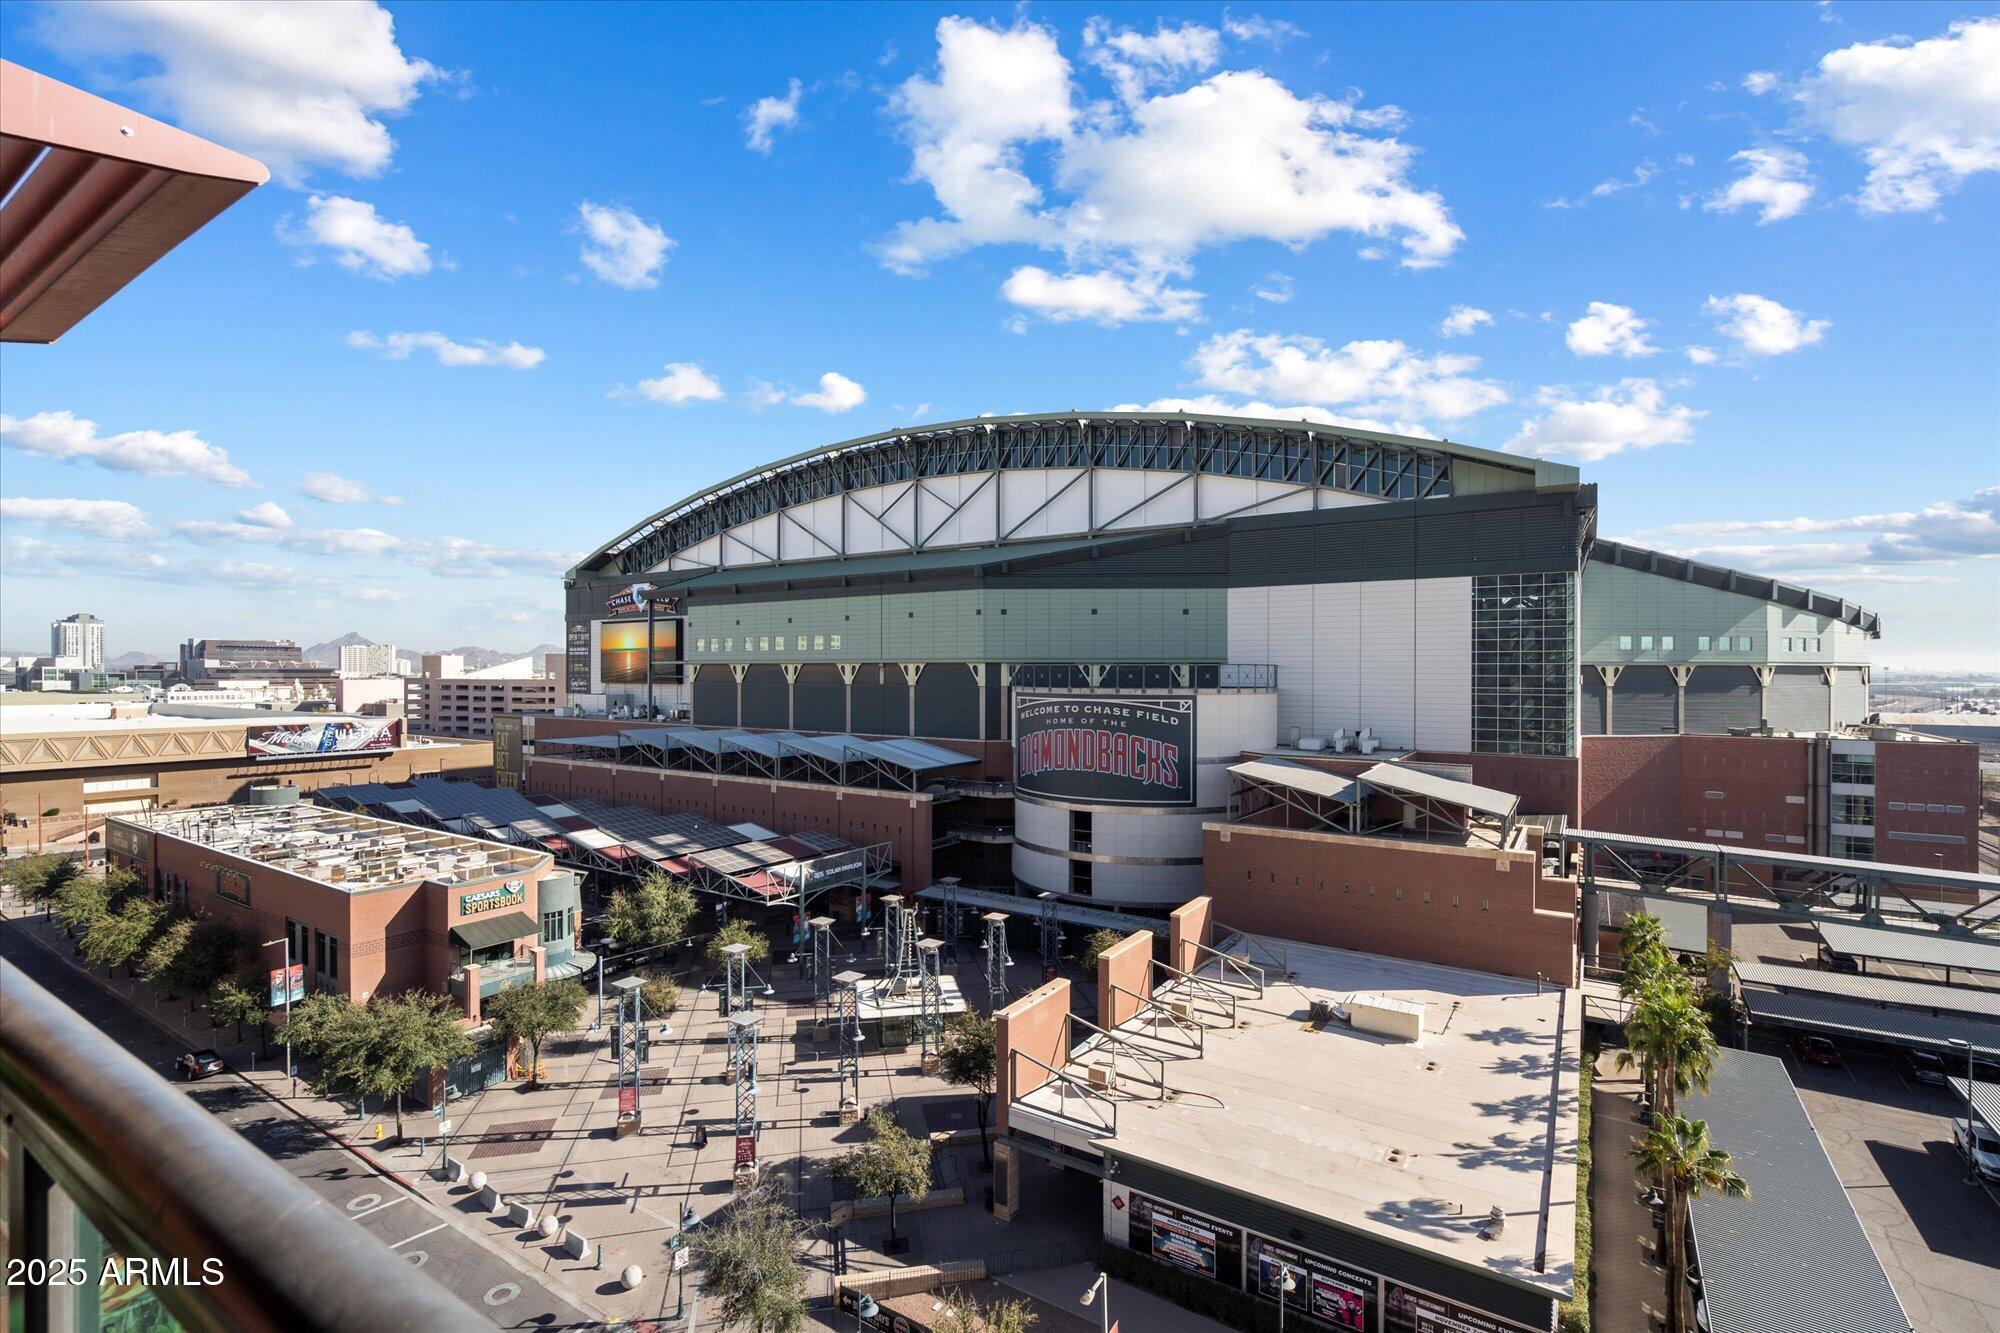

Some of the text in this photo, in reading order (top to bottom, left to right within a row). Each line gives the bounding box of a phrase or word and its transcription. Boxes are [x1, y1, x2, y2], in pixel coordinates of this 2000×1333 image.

[611, 596, 632, 606] CHASE
[1020, 705, 1180, 726] WELCOME TO CHASE FIELD
[1102, 719, 1128, 728] THE
[496, 731, 509, 750] EAT
[496, 751, 510, 770] BET
[1019, 728, 1180, 789] DIAMONDBACKS
[496, 770, 518, 790] CHEER
[825, 865, 842, 876] SOLAR
[464, 889, 501, 903] CAESARS
[464, 892, 523, 915] SPORTSBOOK
[1166, 1219, 1194, 1231] NOVEMBER
[1181, 1214, 1211, 1230] UPCOMING
[1210, 1224, 1234, 1238] EVENTS
[1304, 1258, 1373, 1287] UPCOMING CONCERTS
[1320, 1276, 1349, 1291] SEPTEMBER
[1434, 1314, 1472, 1332] NOVEMBER
[1458, 1312, 1497, 1330] UPCOMING
